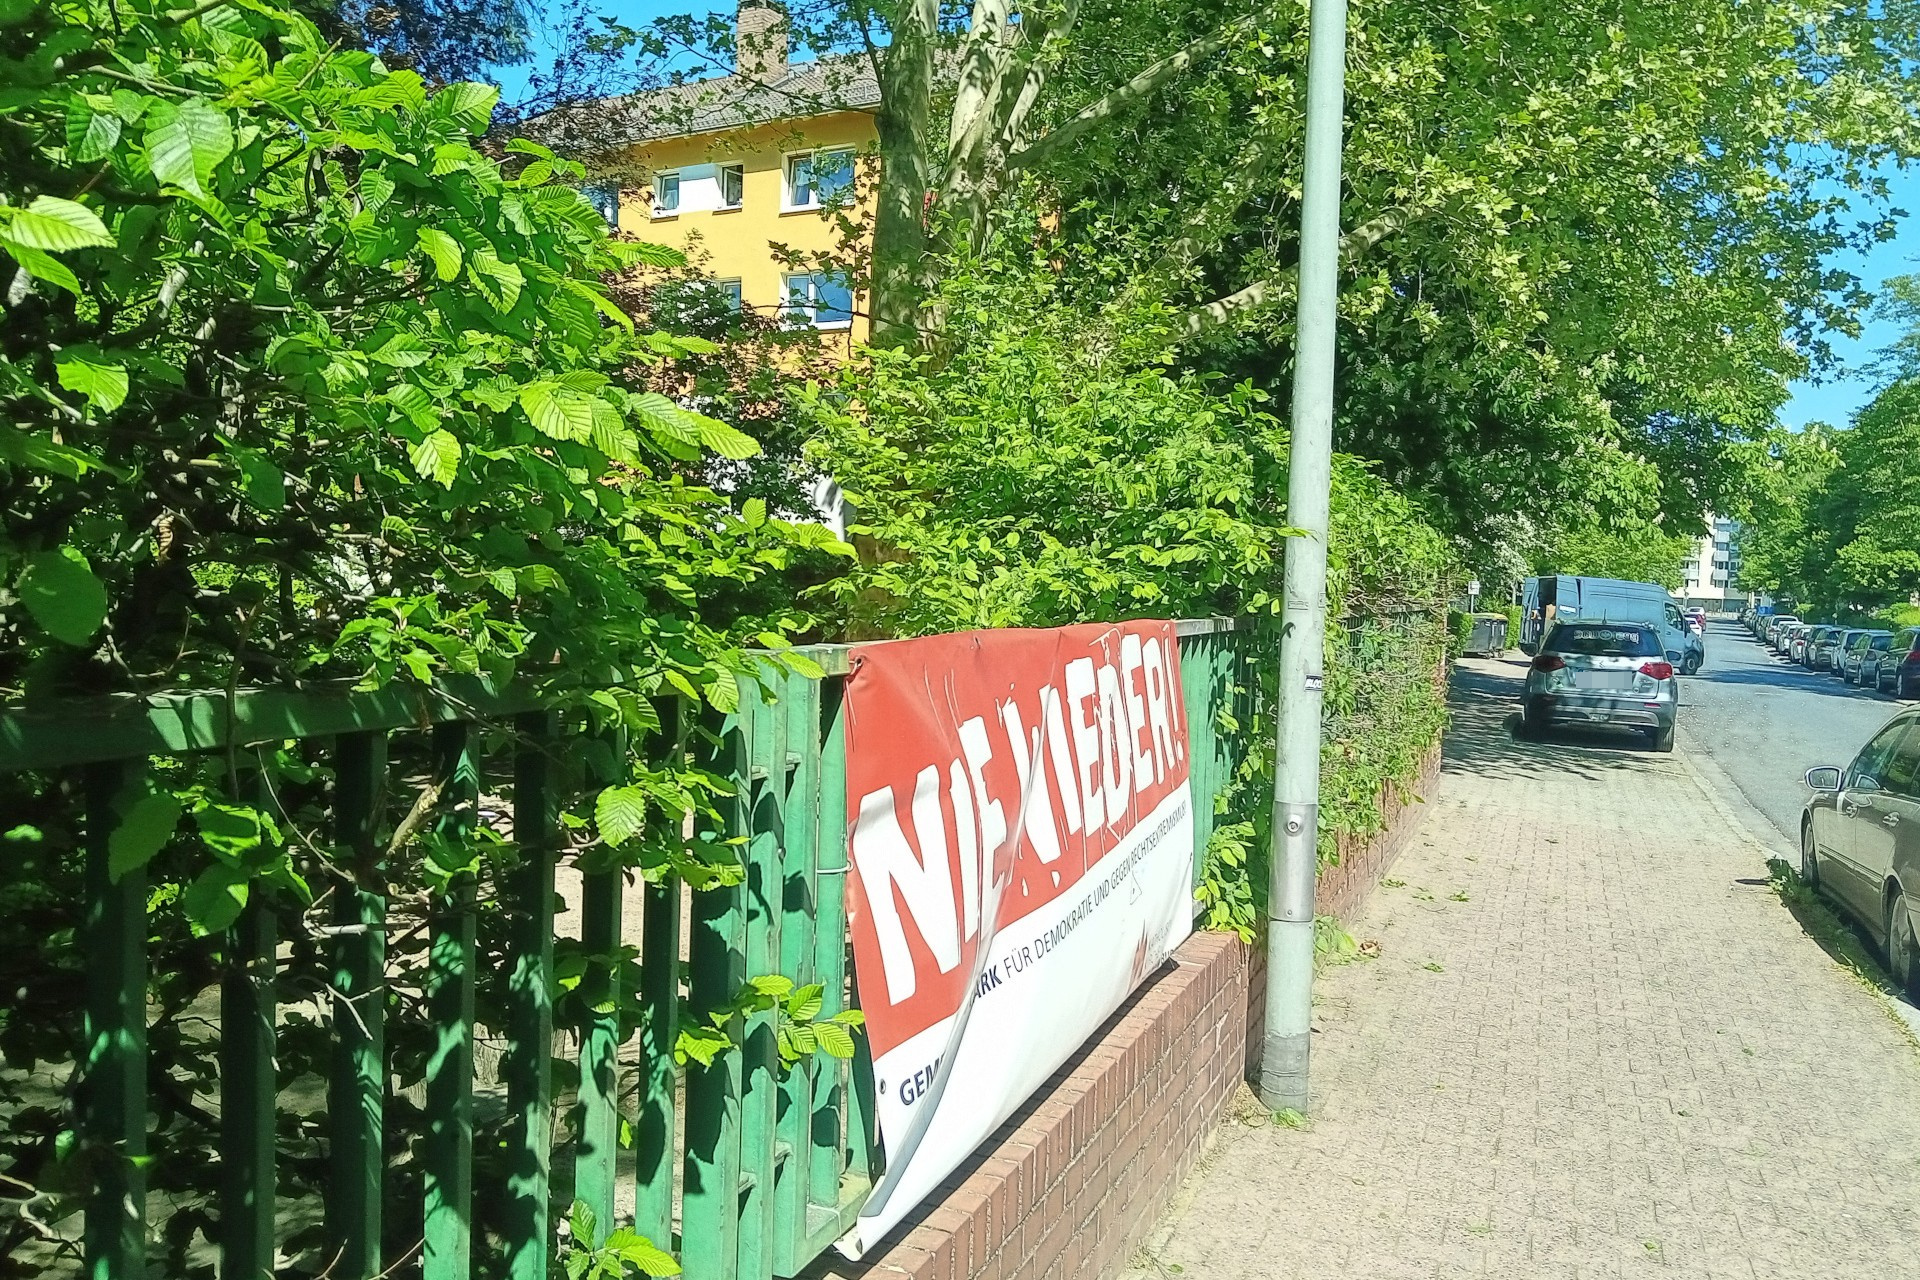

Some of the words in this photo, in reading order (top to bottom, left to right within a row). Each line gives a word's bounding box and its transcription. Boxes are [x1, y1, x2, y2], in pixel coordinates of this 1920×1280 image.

[853, 715, 1007, 1009] NIE
[997, 631, 1186, 865] WIEDER!
[1003, 945, 1033, 979] FÜR
[1034, 894, 1094, 960] DEMOKRATIE
[1094, 879, 1110, 907] UND
[1110, 855, 1131, 889] GEGEN
